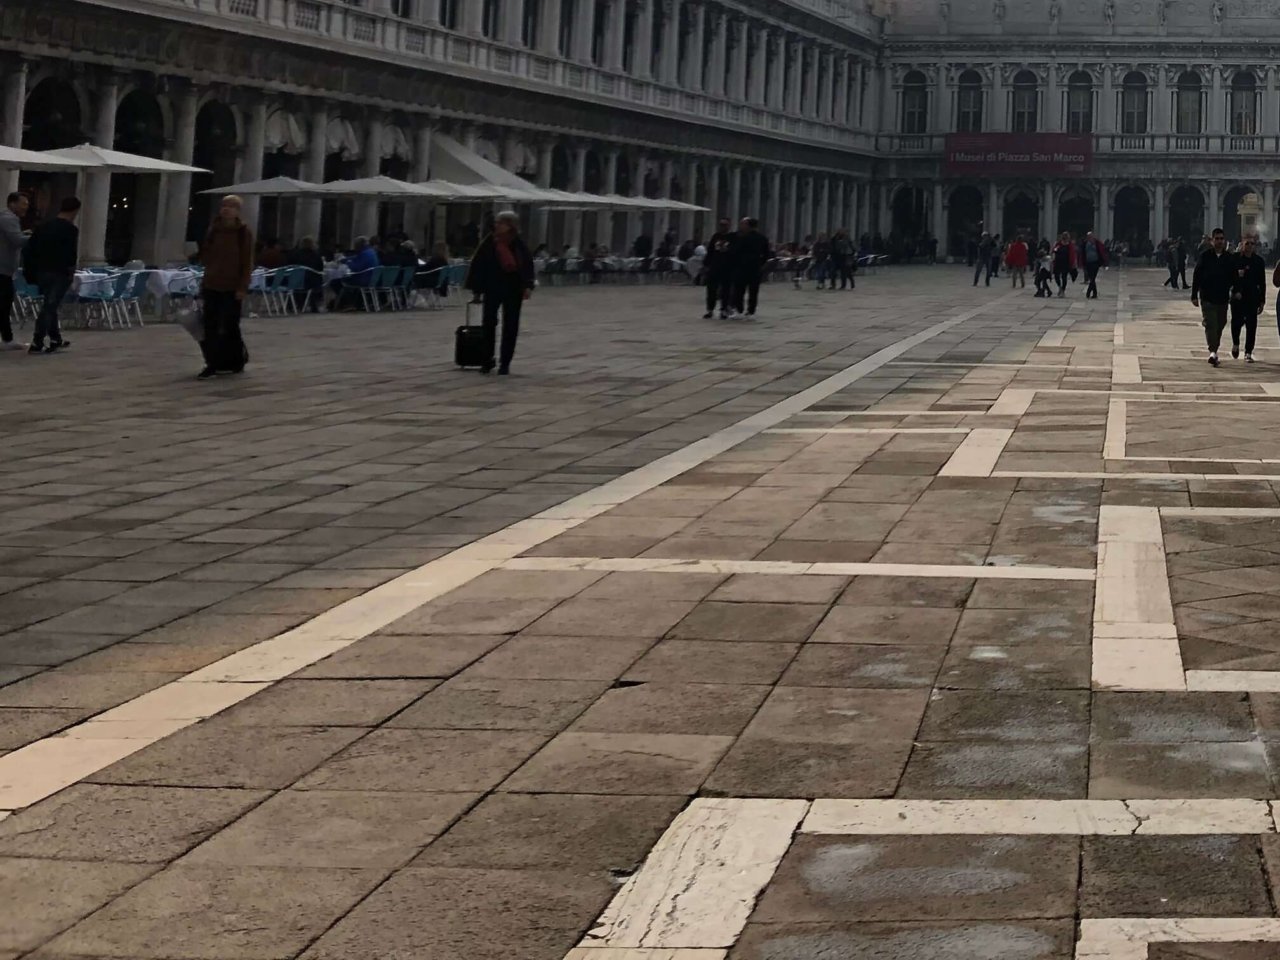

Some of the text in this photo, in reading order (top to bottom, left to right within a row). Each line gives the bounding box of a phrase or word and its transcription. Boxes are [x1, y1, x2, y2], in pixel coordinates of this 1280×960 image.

[955, 152, 984, 162] Musei
[986, 152, 996, 162] di
[998, 152, 1030, 162] Piazza
[1031, 152, 1051, 162] San
[1053, 152, 1085, 162] Marco
